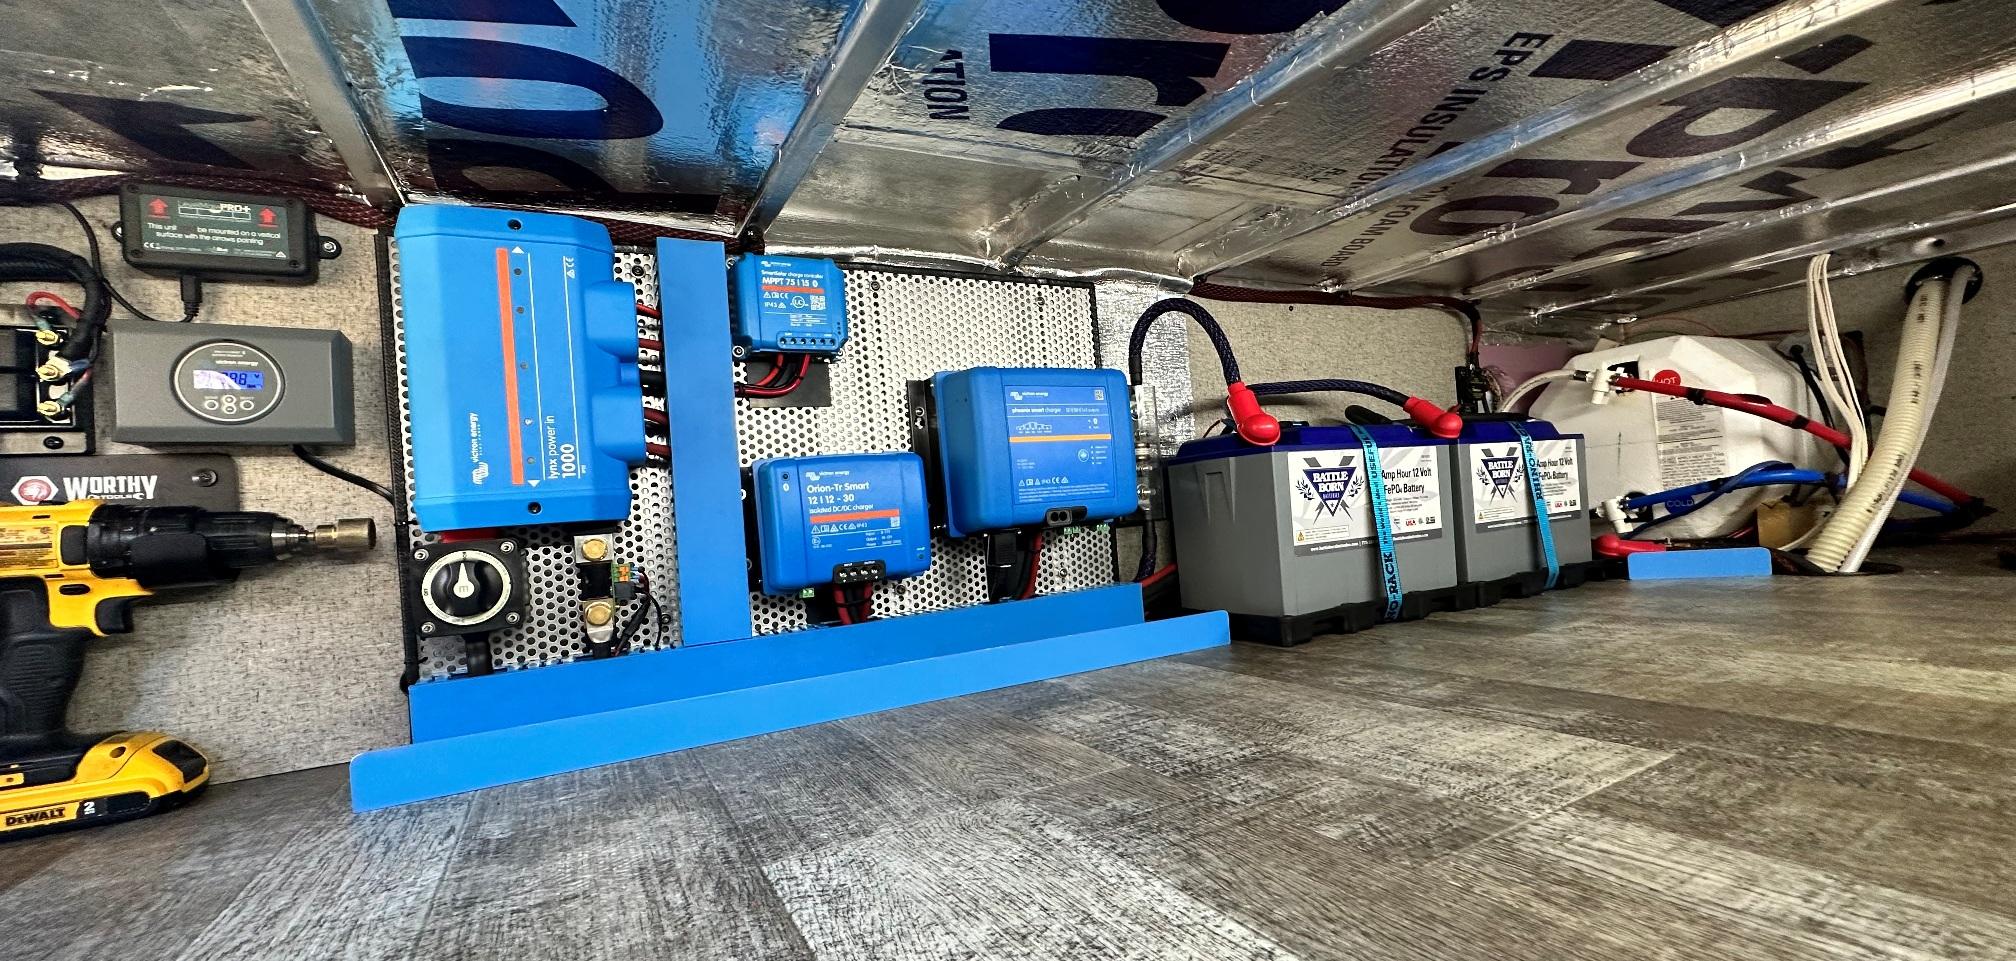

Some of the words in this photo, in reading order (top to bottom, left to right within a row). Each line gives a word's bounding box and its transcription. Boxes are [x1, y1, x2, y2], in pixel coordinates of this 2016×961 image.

[1468, 32, 1554, 81] EPS
[1360, 204, 1420, 236] FOAM
[147, 222, 163, 230] This
[164, 223, 177, 231] unit
[208, 227, 239, 236] mounted
[156, 231, 183, 239] surface
[1321, 238, 1375, 267] BOARD
[762, 276, 784, 285] MPPT
[785, 278, 796, 286] 75
[801, 279, 810, 287] 15
[469, 412, 479, 437] energy
[544, 415, 556, 424] in
[546, 426, 559, 456] power
[471, 438, 479, 463] victron
[560, 443, 576, 479] 1000
[1487, 460, 1513, 470] BATTLE
[1537, 459, 1547, 469] Amp
[1547, 458, 1559, 467] Hour
[1558, 457, 1564, 466] 12
[1564, 456, 1573, 466] Volt
[548, 459, 560, 479] lynx
[1382, 469, 1396, 481] Amp
[1396, 468, 1412, 478] Hour
[1412, 467, 1420, 477] 12
[1420, 466, 1432, 477] Volt
[1491, 470, 1511, 479] BORN
[1552, 470, 1569, 480] Battery
[1312, 470, 1349, 482] BATTLE
[63, 475, 158, 501] WORTHY
[806, 483, 843, 493] Orion-Tr
[843, 481, 870, 491] Smart
[1317, 481, 1345, 493] BORN
[1403, 483, 1425, 493] Battery
[808, 495, 818, 504] 12
[825, 494, 835, 504] 12
[843, 493, 855, 502] 30
[1666, 499, 1693, 508] COLD
[809, 506, 832, 514] isolated
[832, 504, 852, 512] DC/DC
[852, 503, 874, 511] charger
[83, 801, 95, 812] 2
